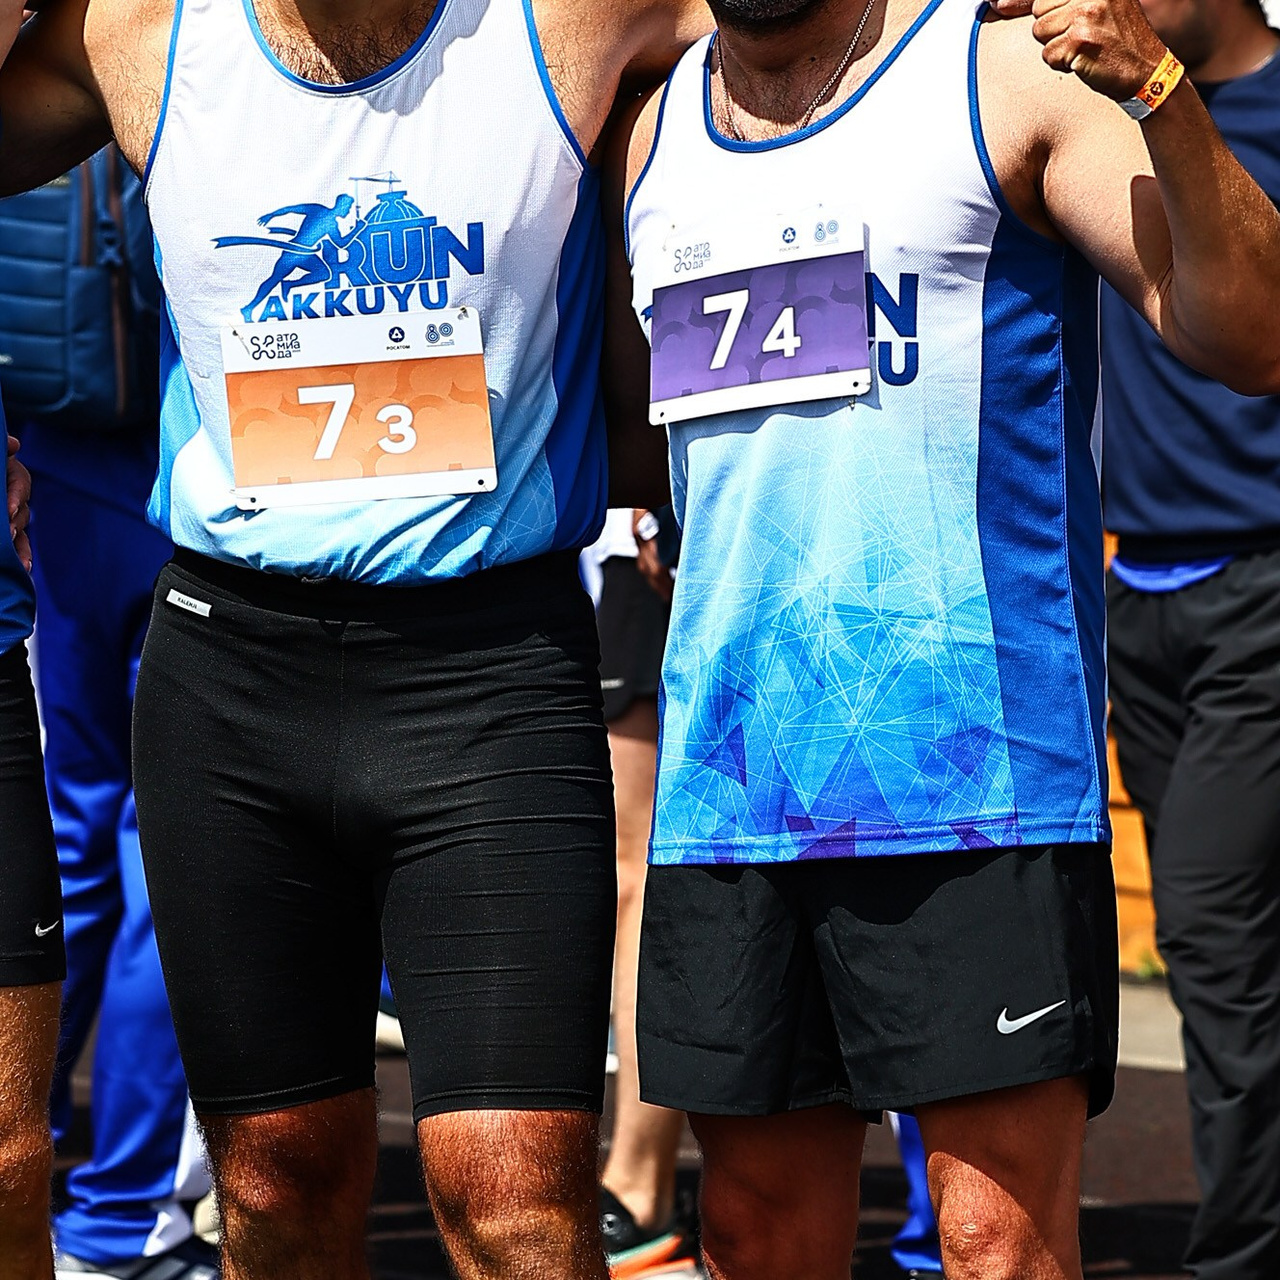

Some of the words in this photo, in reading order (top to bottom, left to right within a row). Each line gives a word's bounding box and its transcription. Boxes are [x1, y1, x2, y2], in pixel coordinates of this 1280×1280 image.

[324, 222, 485, 289] RUN
[259, 280, 448, 322] AKKUYU
[703, 288, 750, 370] 7
[762, 306, 802, 358] 4
[297, 383, 355, 460] 7
[375, 404, 418, 455] 3
